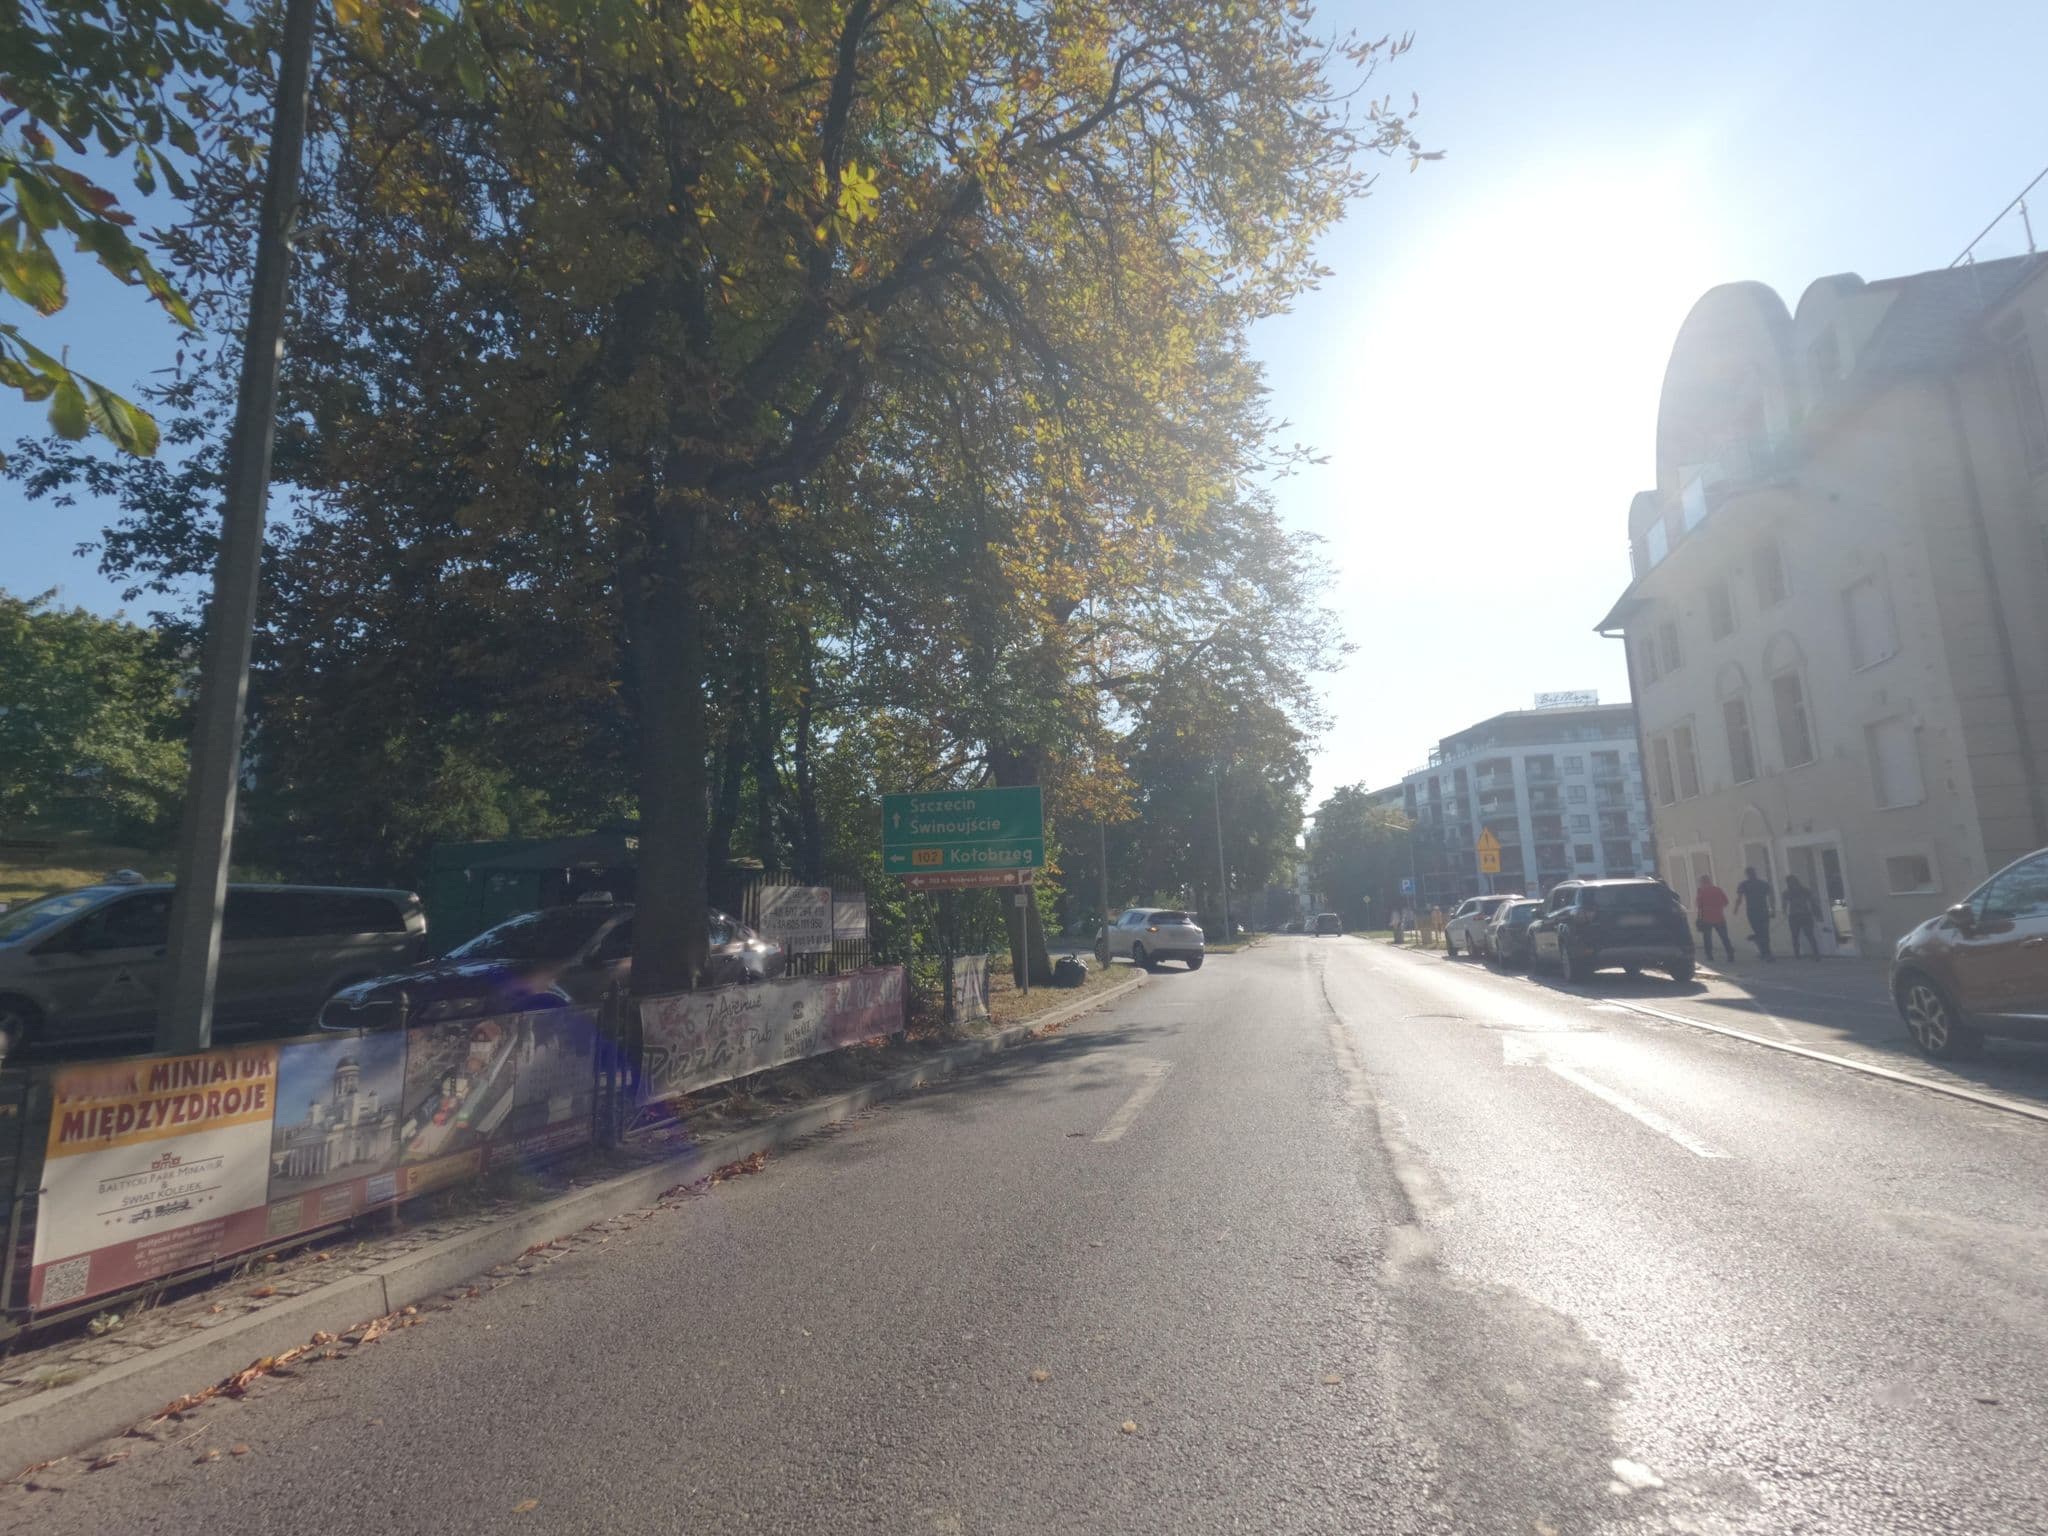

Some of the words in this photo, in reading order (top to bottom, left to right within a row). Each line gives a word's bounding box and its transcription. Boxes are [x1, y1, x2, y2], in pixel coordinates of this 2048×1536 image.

[911, 797, 976, 813] Szczecin
[910, 815, 1000, 835] Świnoujście
[917, 851, 938, 863] 102
[950, 848, 1033, 863] Kołobrzeg
[719, 994, 762, 1017] Avenue
[747, 1022, 775, 1046] Pub
[148, 1053, 272, 1092] MINIATUR
[641, 1041, 731, 1098] Pizza
[58, 1083, 266, 1143] MIĘDZYZDROJE
[157, 1182, 203, 1199] KOLEJEK
